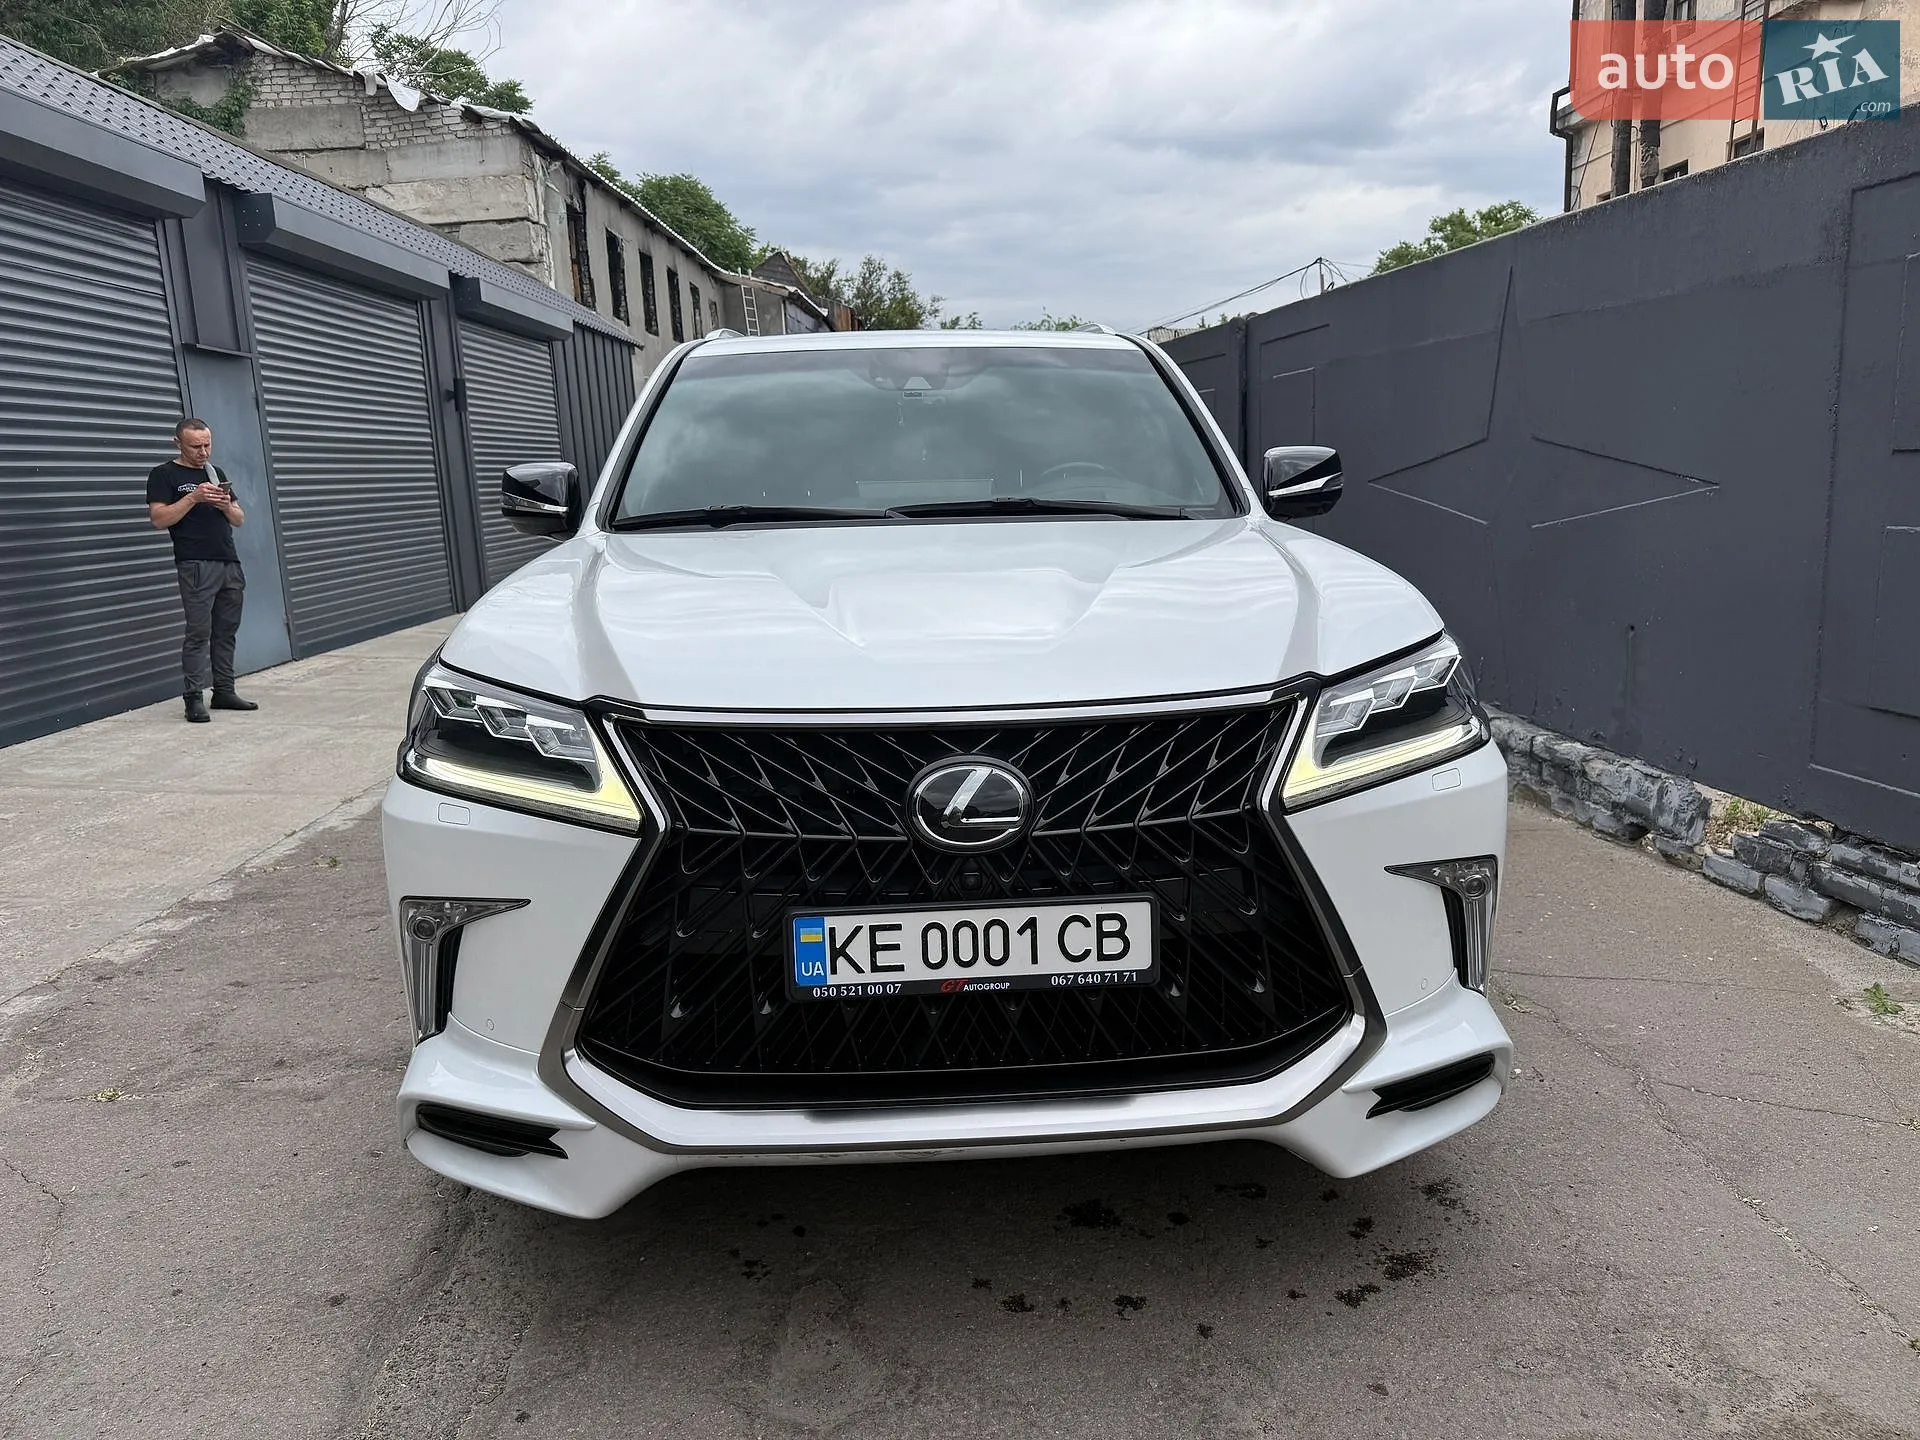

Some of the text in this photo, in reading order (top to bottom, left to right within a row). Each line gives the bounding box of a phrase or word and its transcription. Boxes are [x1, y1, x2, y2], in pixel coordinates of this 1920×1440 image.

[828, 912, 1131, 976] KE 0001 CB
[801, 961, 824, 977] UA
[1051, 971, 1136, 986] 067 640 71 71
[813, 983, 902, 998] 050 521 00 07
[963, 982, 1010, 991] AUTOGROUP
